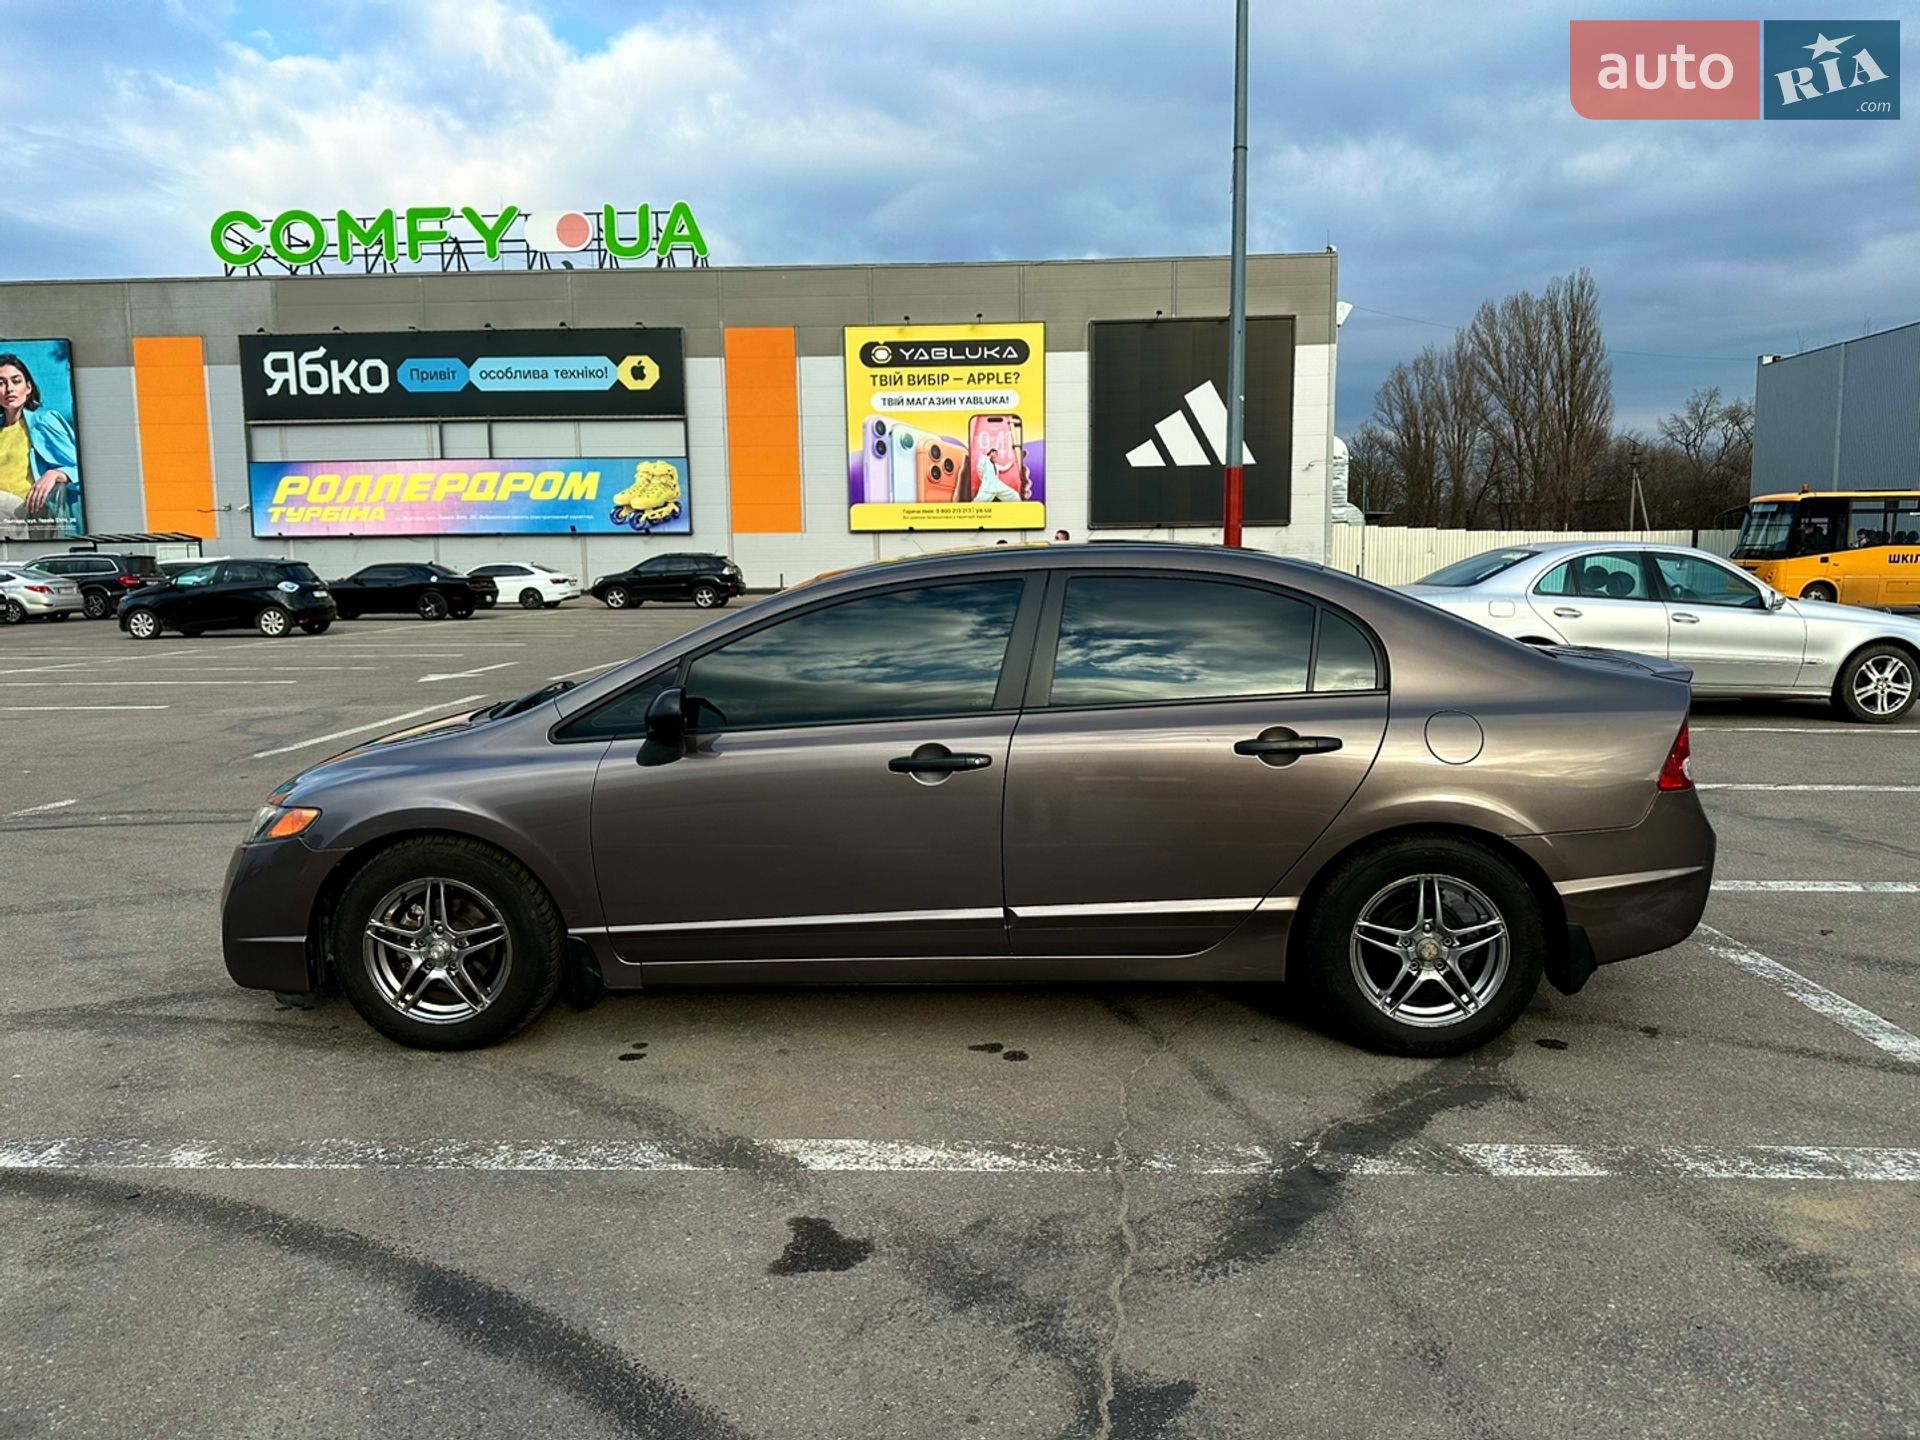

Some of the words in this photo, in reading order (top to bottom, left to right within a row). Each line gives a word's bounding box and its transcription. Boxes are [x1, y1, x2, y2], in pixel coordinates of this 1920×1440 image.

[210, 205, 520, 267] COMFY
[602, 201, 711, 261] UA
[898, 346, 1019, 361] YABLUKA
[263, 346, 390, 396] Ябко
[409, 367, 457, 383] Привіт
[479, 366, 549, 380] особлива
[554, 366, 609, 380] техніко!
[870, 371, 904, 387] ТВІЙ
[907, 373, 950, 387] ВИБІР
[966, 371, 1021, 386] APPLE?
[881, 395, 905, 407] ТВІЙ
[906, 396, 956, 407] МАГАЗИН
[958, 395, 1010, 406] YABLUKA!
[271, 471, 601, 504] РОЛЛЕРДРОМ
[267, 504, 387, 524] ТУРБІНА
